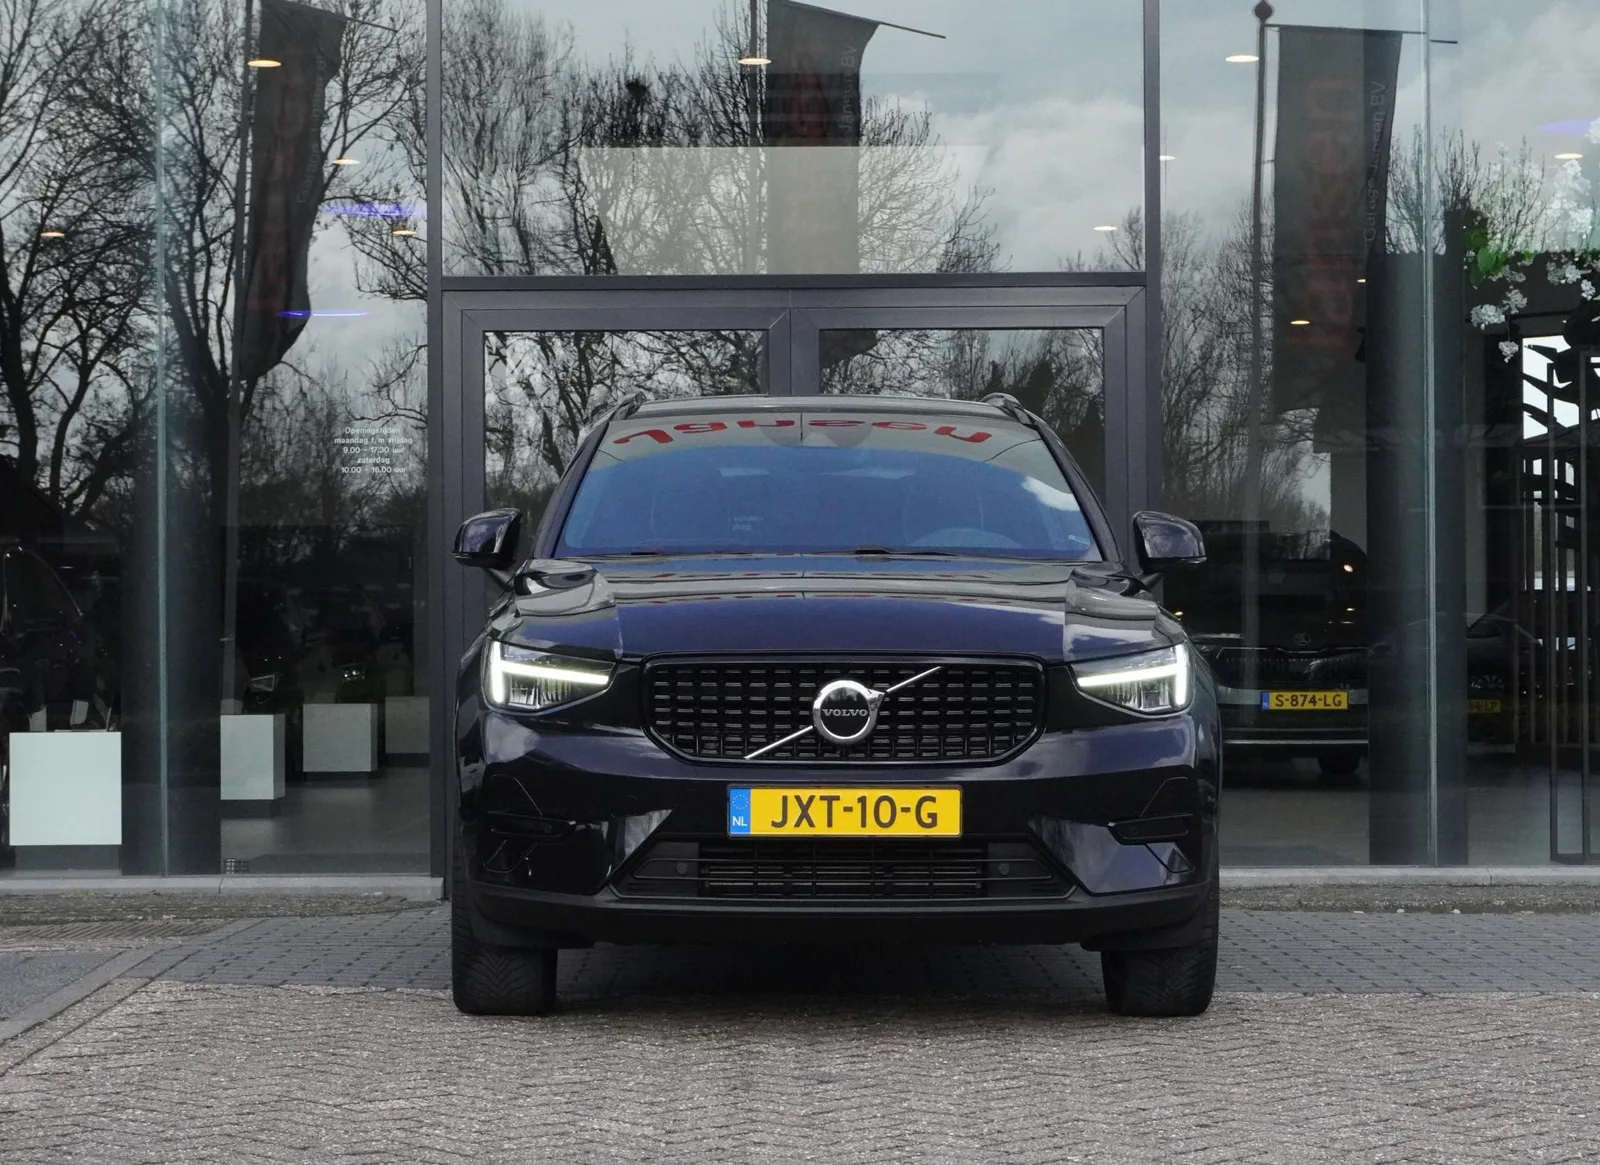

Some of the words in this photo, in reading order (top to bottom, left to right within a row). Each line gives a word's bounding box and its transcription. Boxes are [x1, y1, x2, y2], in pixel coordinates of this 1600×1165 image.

[344, 427, 400, 435] Openingstijden
[334, 437, 368, 445] maandag
[388, 437, 413, 445] vrijdag
[370, 446, 390, 454] 17.30
[357, 456, 390, 465] zaterdag
[1275, 693, 1343, 707] S-874-LG
[821, 708, 868, 717] VOLVO
[770, 794, 938, 828] JXT-10-G
[732, 815, 748, 827] NL
